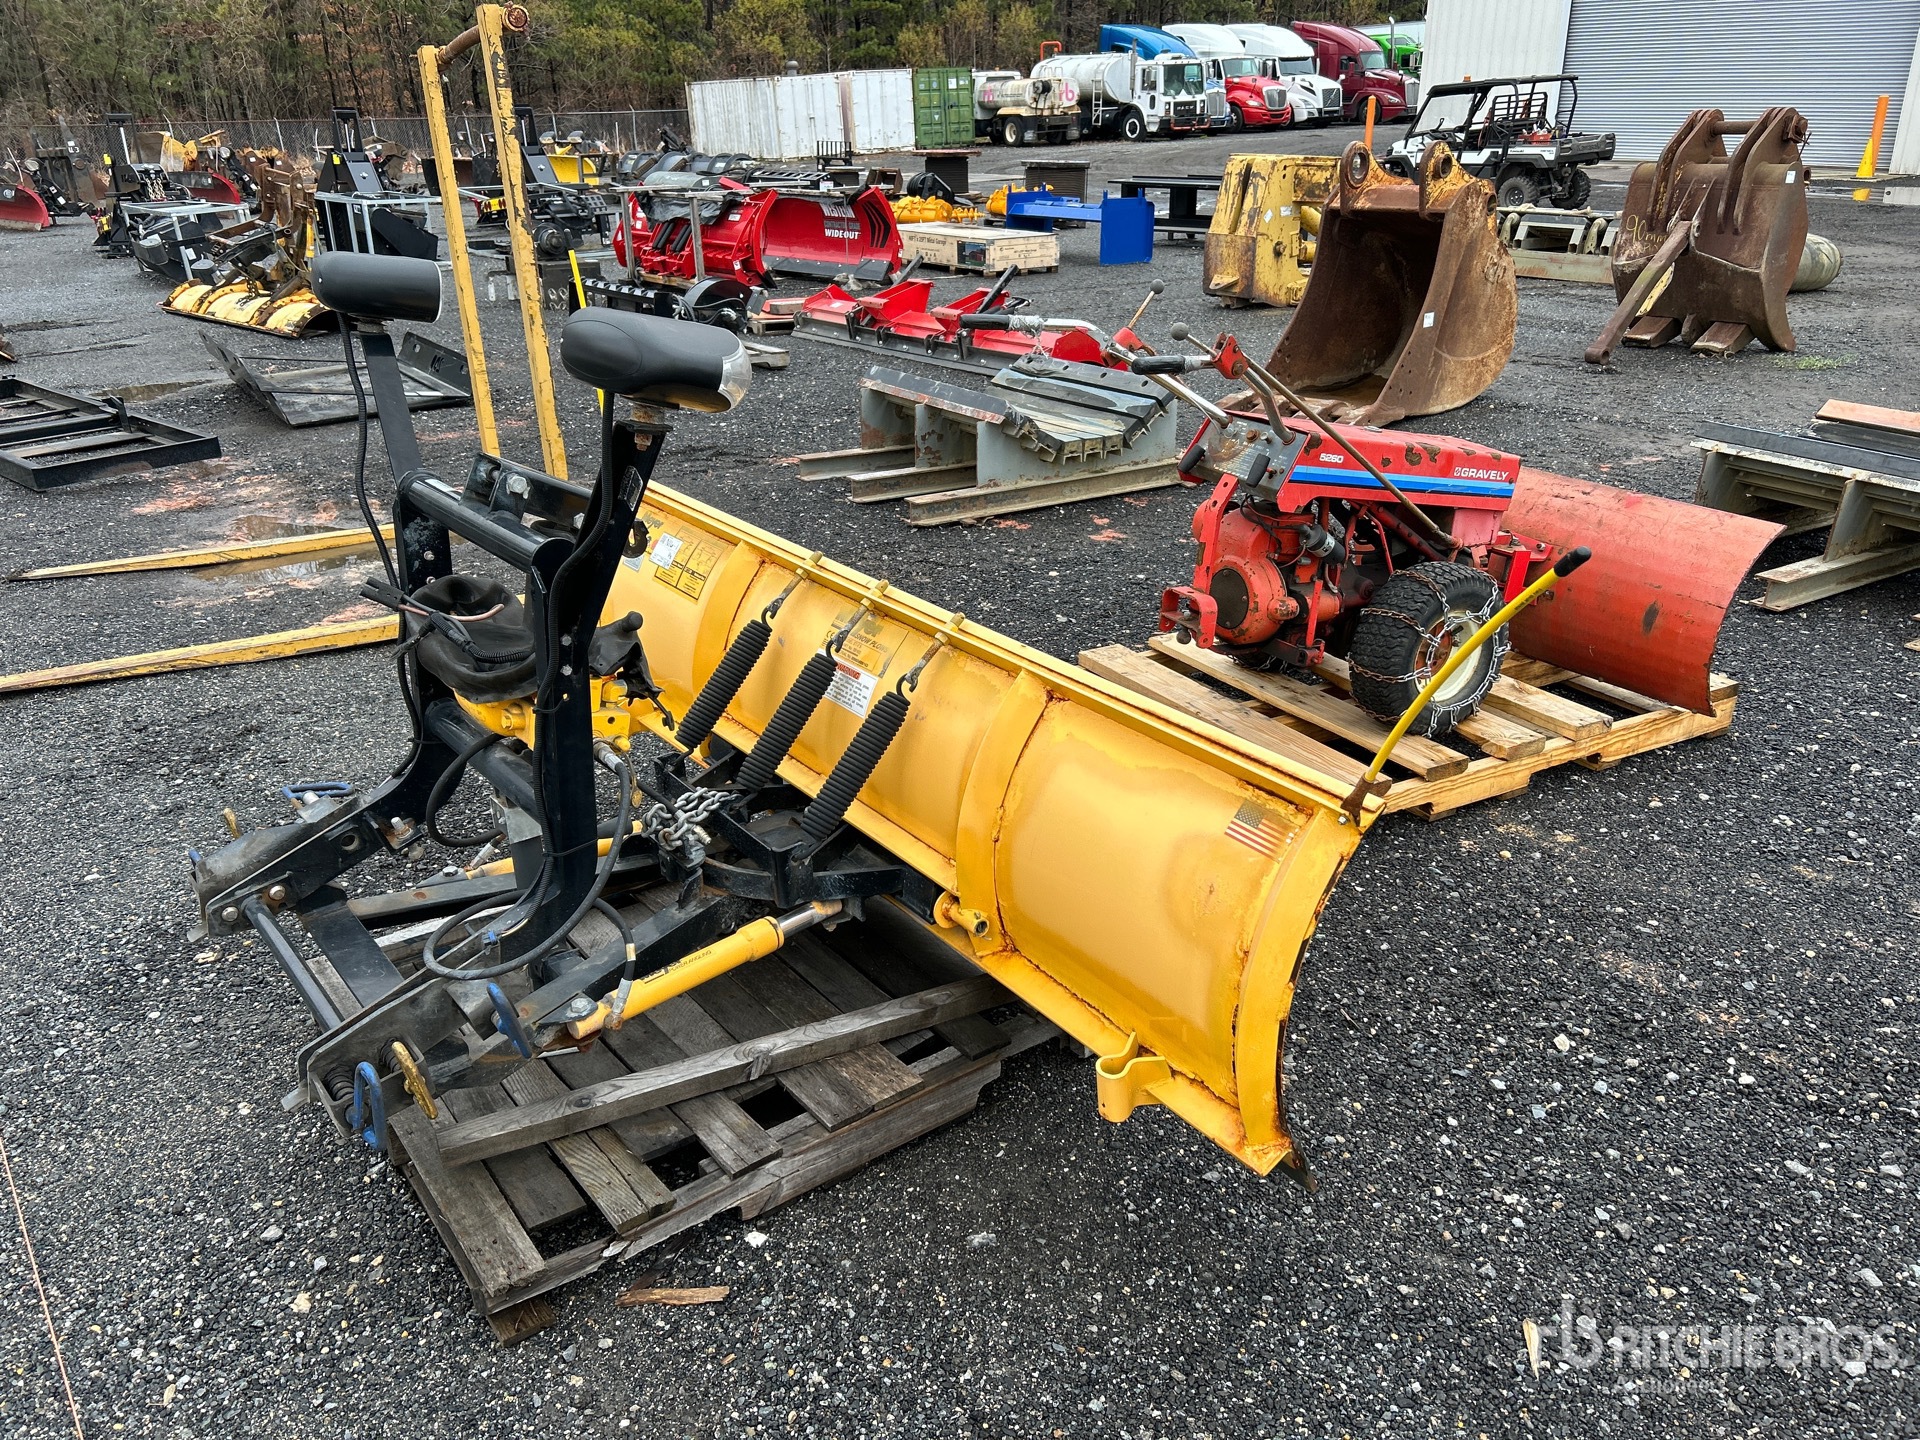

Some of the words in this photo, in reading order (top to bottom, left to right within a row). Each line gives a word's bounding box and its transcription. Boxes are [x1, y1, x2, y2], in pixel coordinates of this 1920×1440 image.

[1058, 82, 1075, 102] rb
[1319, 453, 1344, 464] 5260
[1461, 467, 1509, 481] GRAVELY
[854, 633, 871, 645] SNOW
[688, 949, 713, 964] ANGLING
